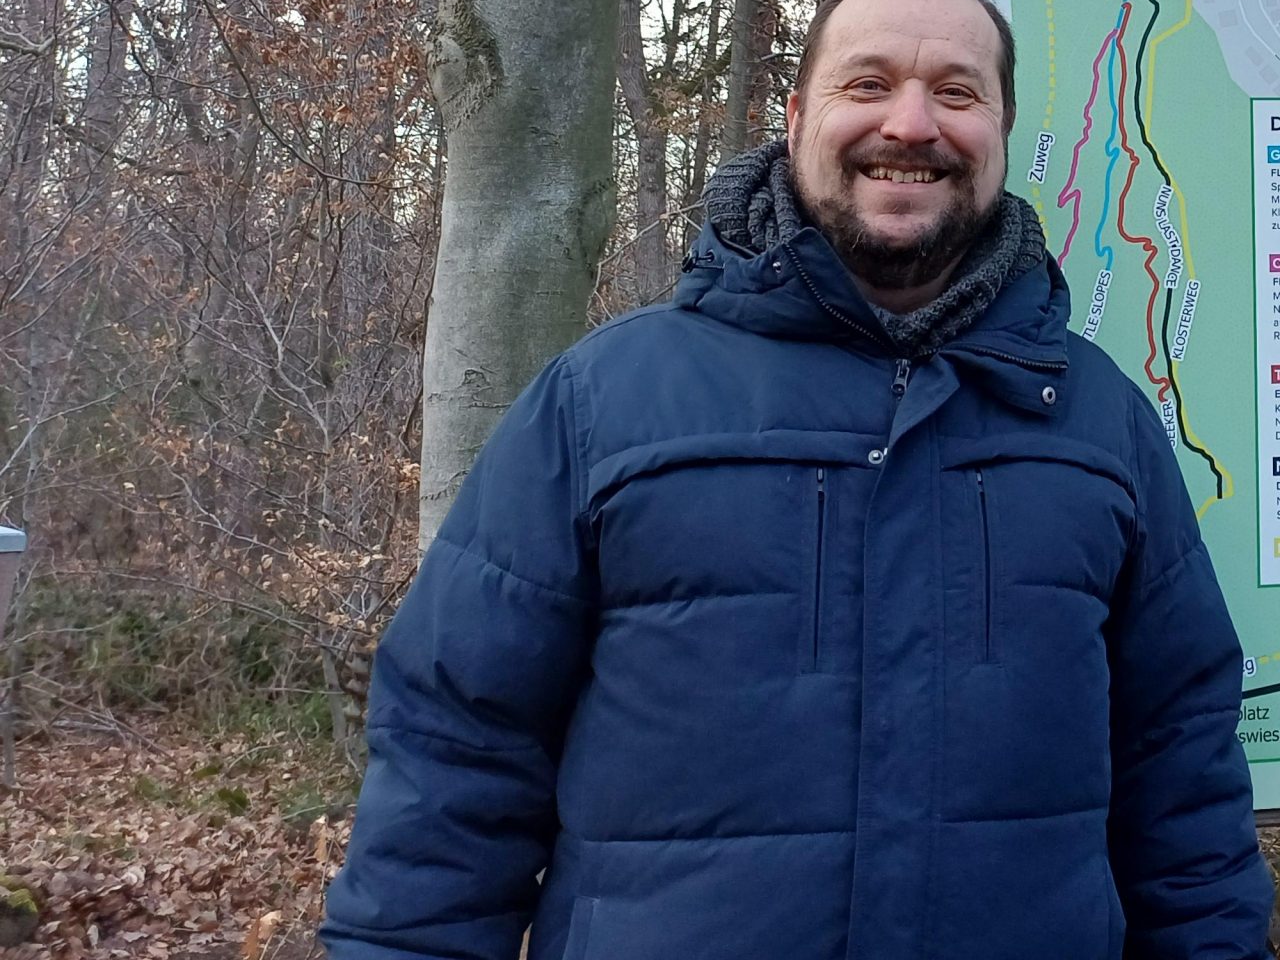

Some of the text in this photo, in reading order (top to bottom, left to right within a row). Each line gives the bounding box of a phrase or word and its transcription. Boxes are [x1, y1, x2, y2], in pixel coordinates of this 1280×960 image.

[1029, 133, 1054, 182] Zuweg
[1155, 186, 1181, 287] NUNS LAST DANCE
[1091, 271, 1111, 315] SLOPES
[1172, 281, 1199, 360] KLOSTERWEG
